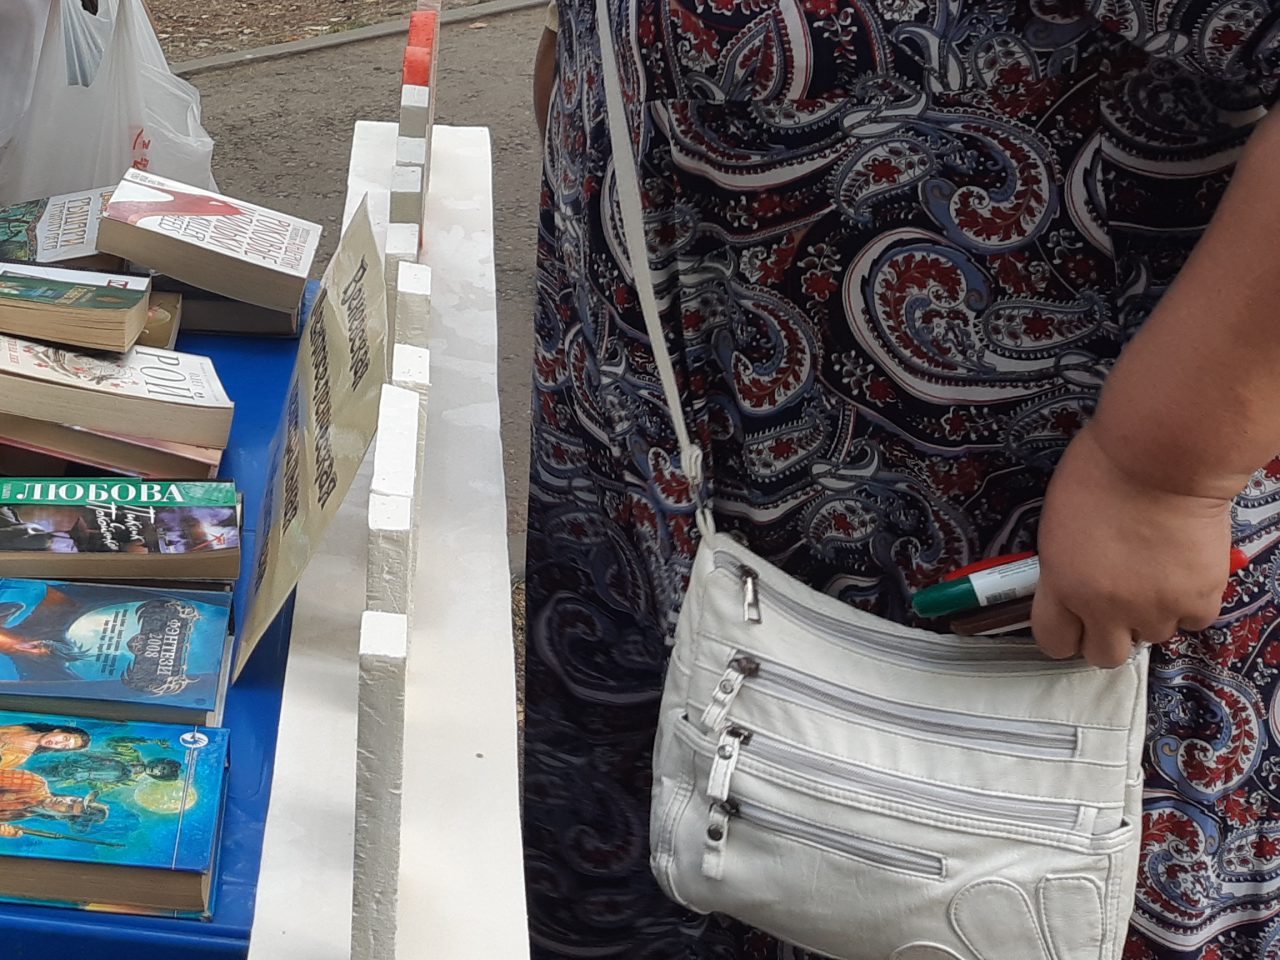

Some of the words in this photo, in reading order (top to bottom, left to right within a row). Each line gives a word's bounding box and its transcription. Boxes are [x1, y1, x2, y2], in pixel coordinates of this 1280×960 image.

[65, 195, 93, 246] РЫЦАРИ
[181, 213, 213, 243] KILLER
[242, 213, 291, 265] РОКОВЫЕ
[133, 349, 206, 400] РОЙ
[15, 480, 184, 502] ЛЮБОВА
[141, 632, 163, 658] 2008
[153, 618, 183, 675] ФЭНТЕЗИ
